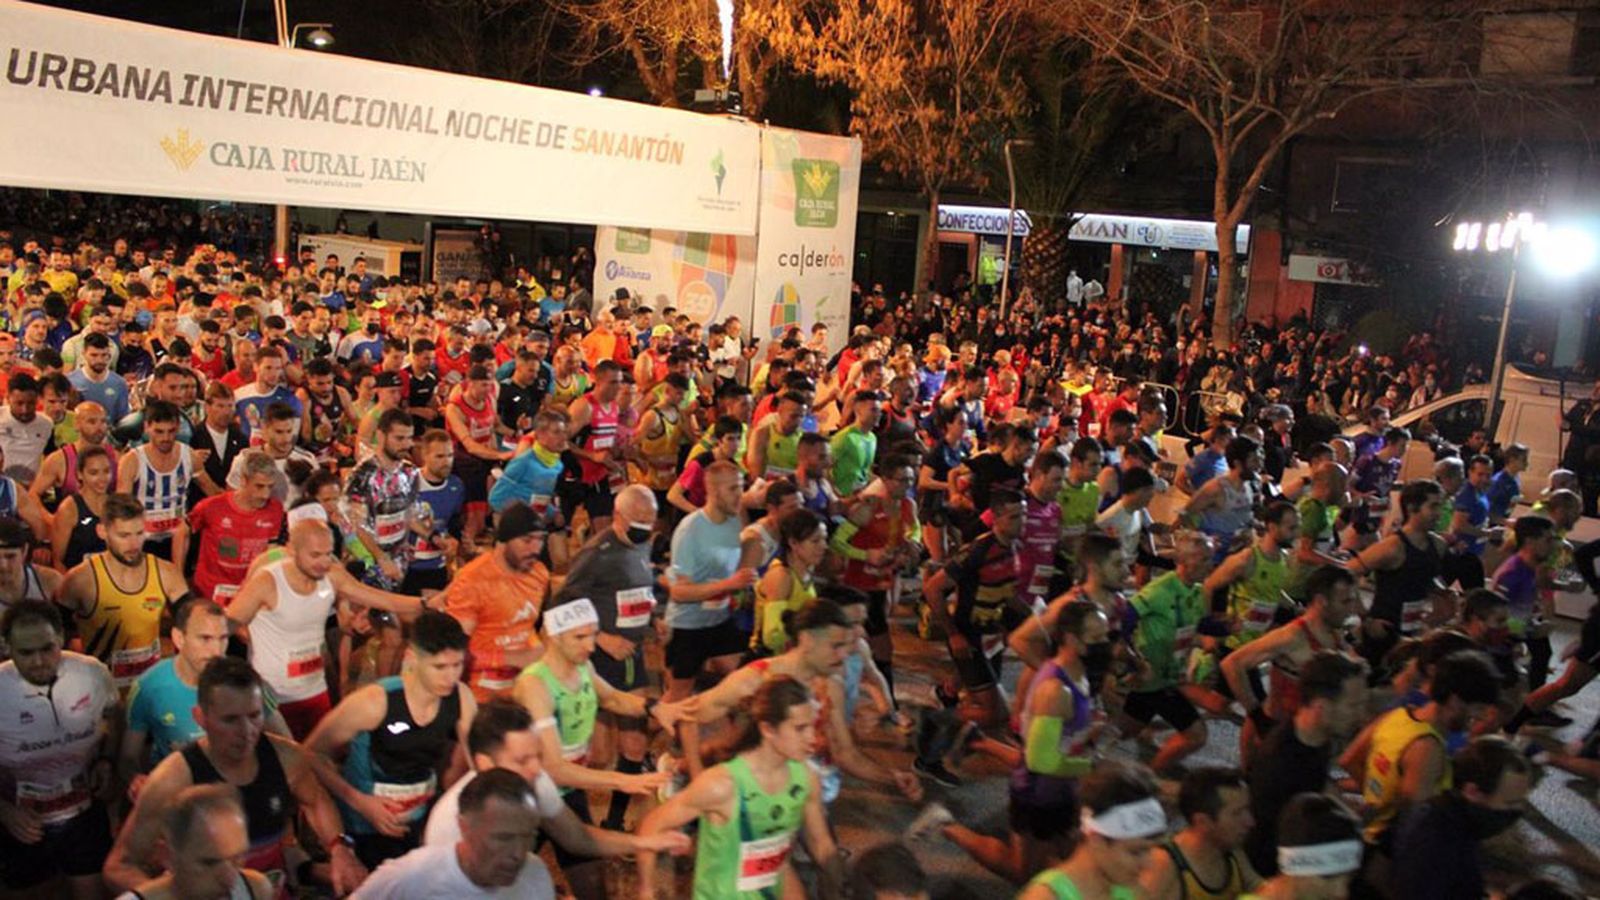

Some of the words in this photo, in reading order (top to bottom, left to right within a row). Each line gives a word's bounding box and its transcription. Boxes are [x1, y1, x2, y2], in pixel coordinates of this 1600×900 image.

[6, 48, 173, 104] URBANA
[178, 73, 439, 135] INTERNACIONAL
[444, 109, 533, 145] NOCHE
[535, 122, 568, 150] DE
[571, 125, 616, 156] SAN
[614, 132, 685, 165] ANTÓN
[209, 142, 275, 171] CAJA
[282, 148, 365, 178] RURAL
[370, 156, 427, 183] JAÉN
[937, 208, 1027, 233] CONFECCIONES
[777, 244, 846, 277] calderón
